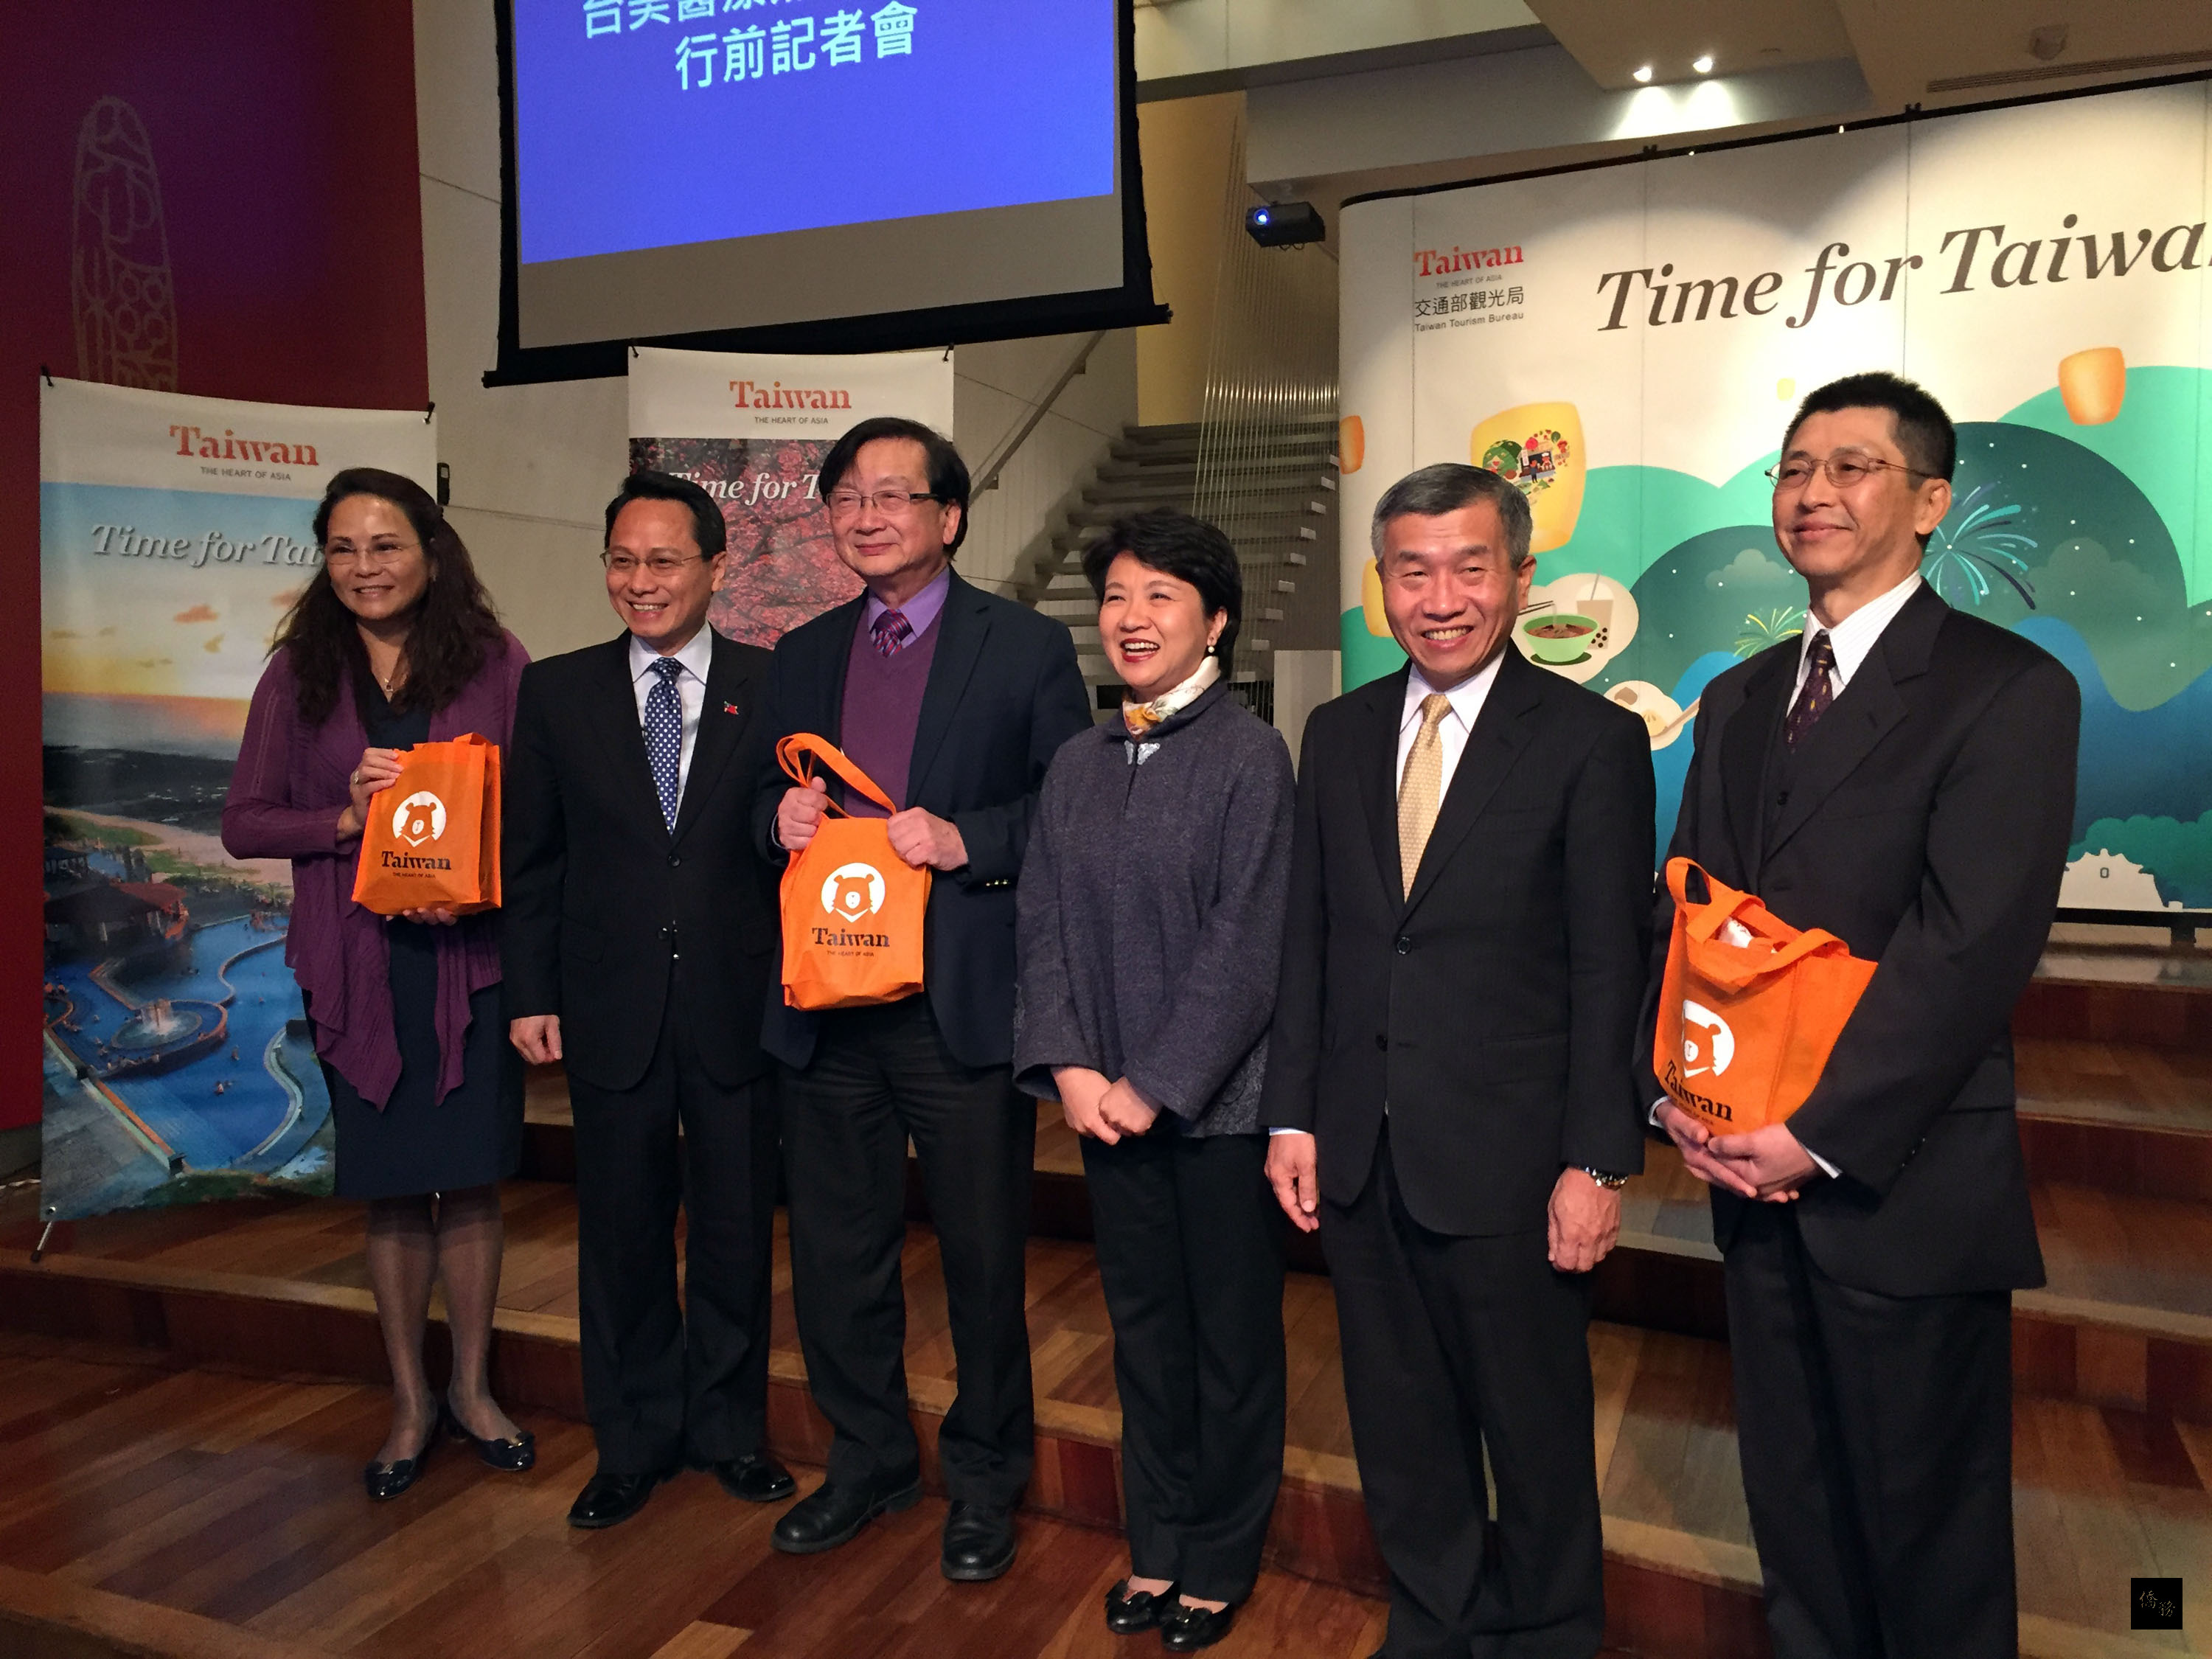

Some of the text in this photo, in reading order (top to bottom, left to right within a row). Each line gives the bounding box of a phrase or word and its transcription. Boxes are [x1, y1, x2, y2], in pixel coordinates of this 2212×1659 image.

[675, 1, 918, 90] 行前記者會
[1414, 246, 1524, 276] Taiwan
[1597, 214, 2212, 331] Time for Taiwa
[1415, 286, 1524, 317] 交通部觀光局
[1415, 312, 1524, 332] Taiwan Tourism Bureau
[729, 381, 852, 408] Taiwan
[169, 425, 319, 466] Taiwan
[201, 466, 291, 481] THE HEART OF ASIA
[669, 472, 744, 498] me
[745, 472, 797, 506] for
[92, 524, 191, 559] Time
[190, 531, 256, 568] for
[381, 851, 451, 870] Taiwan
[812, 928, 890, 947] Taiwan
[1664, 1060, 1733, 1121] Taiwan
